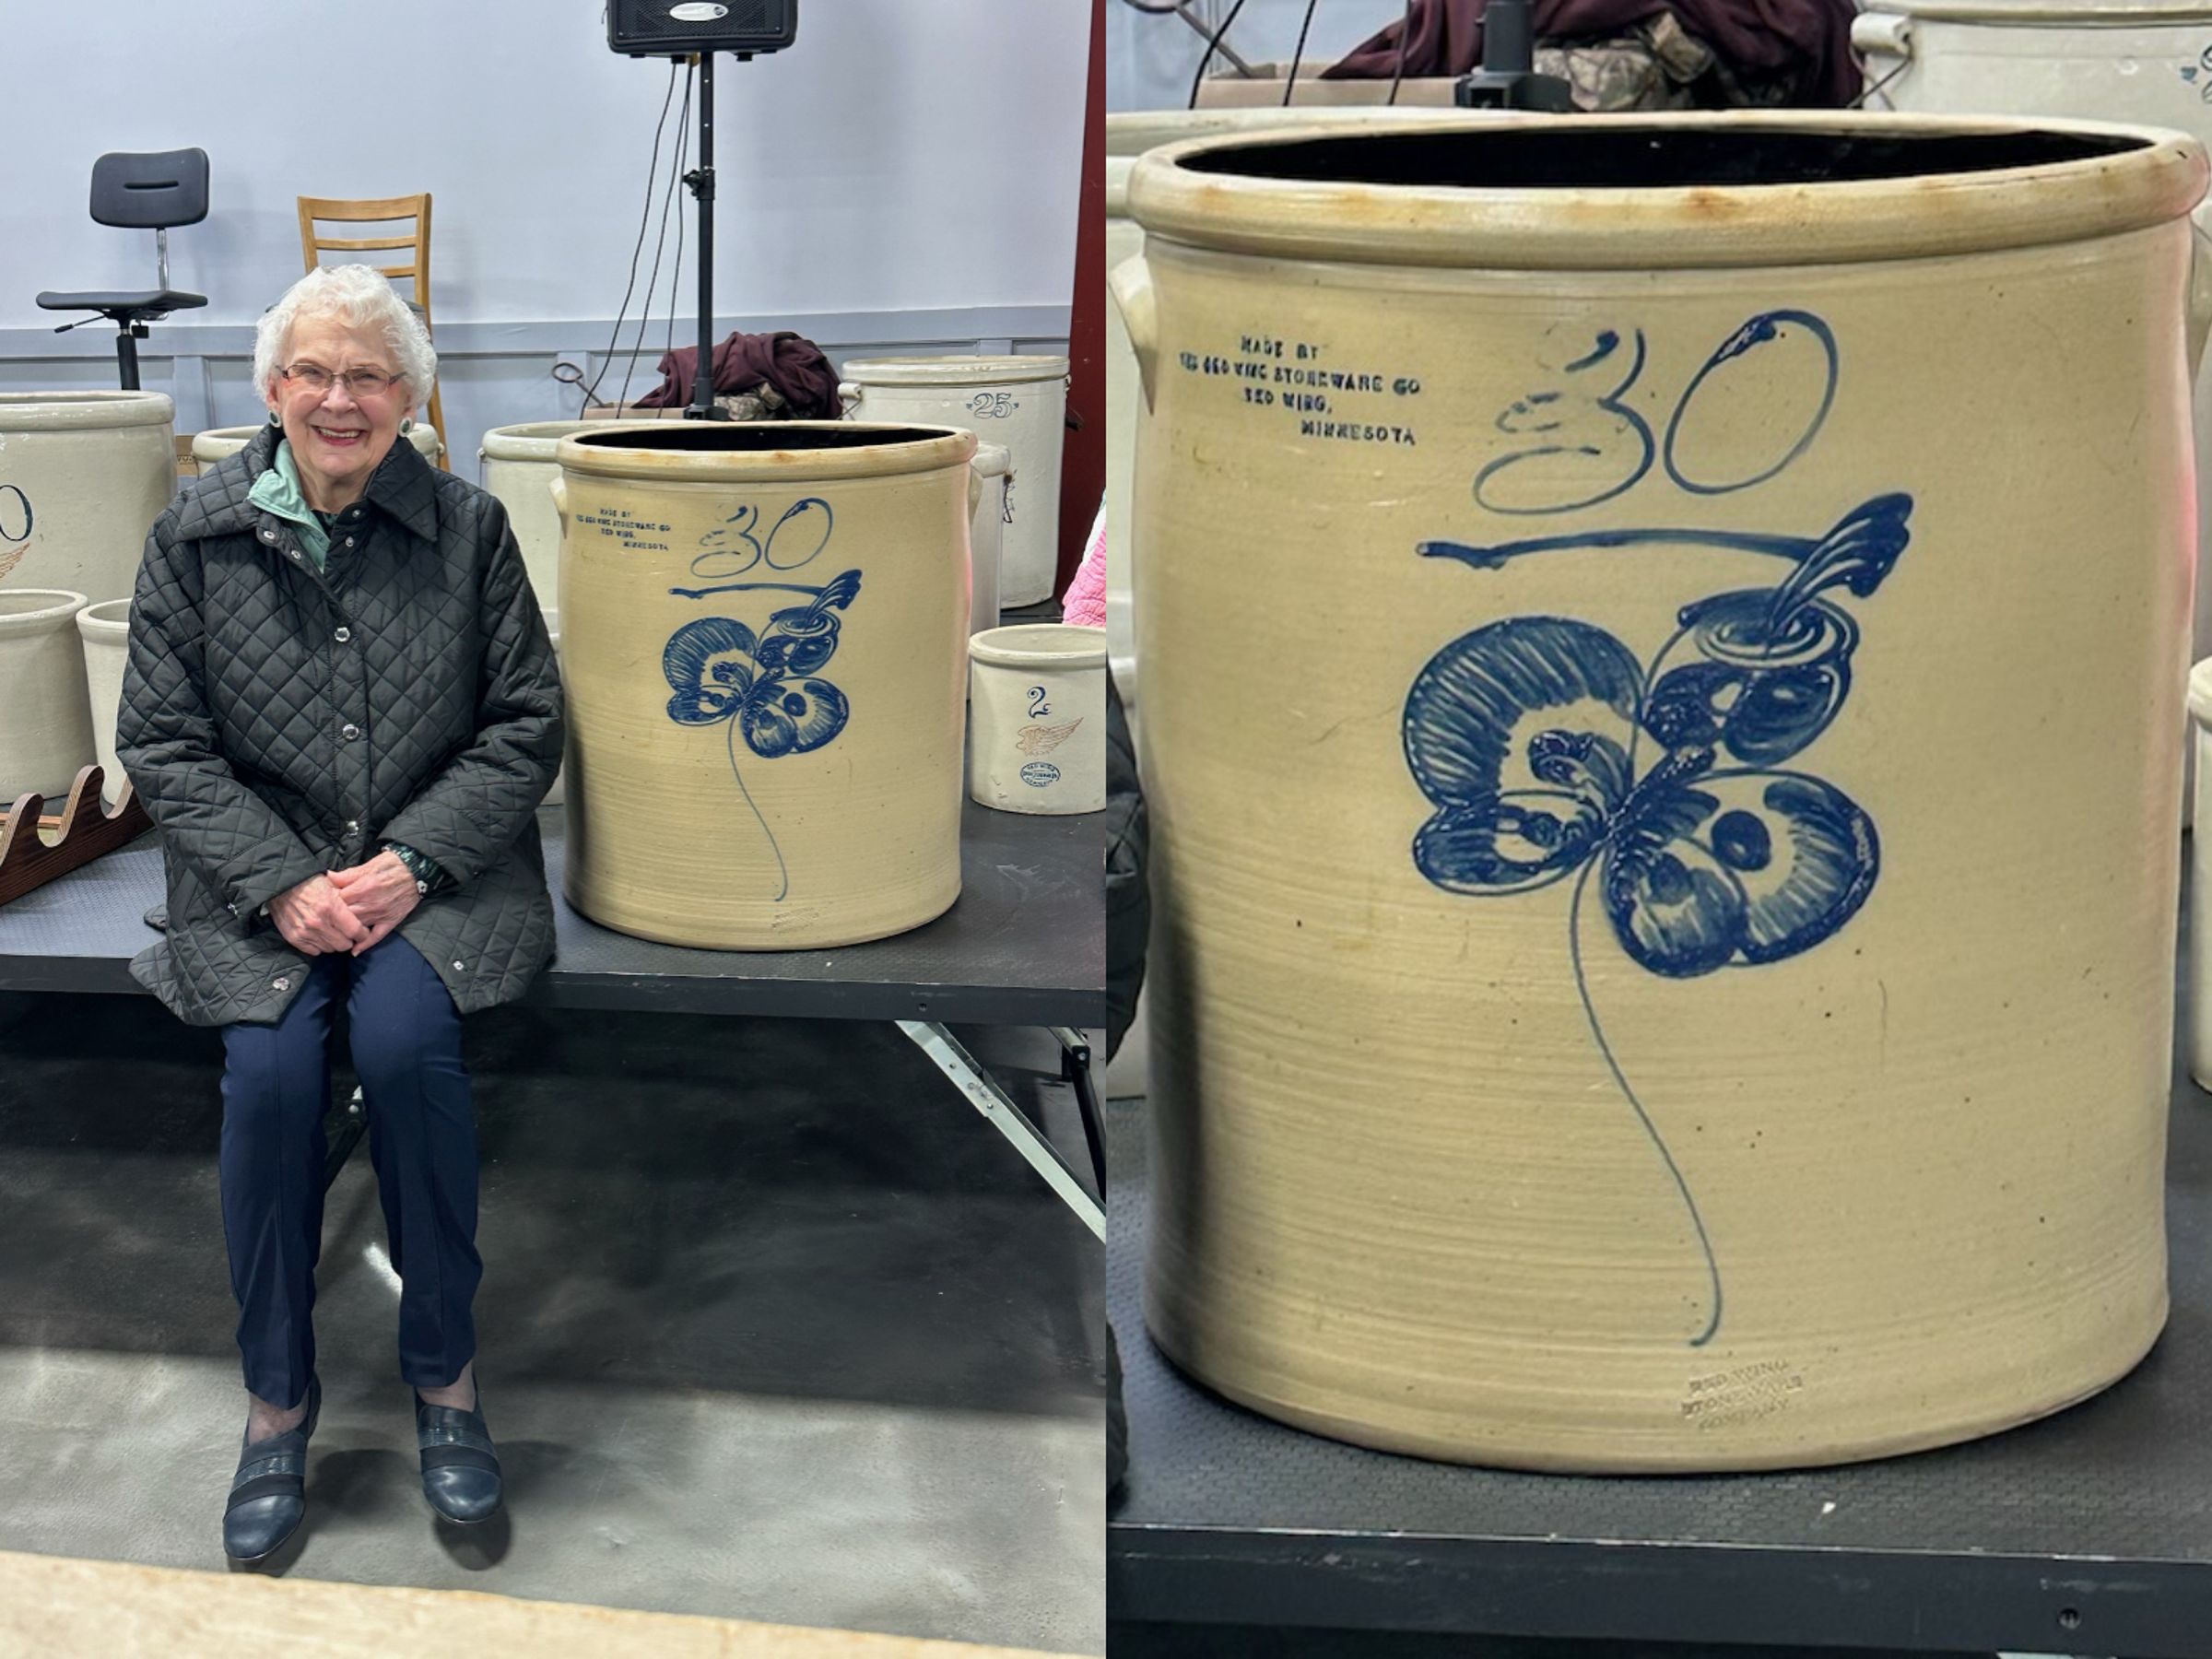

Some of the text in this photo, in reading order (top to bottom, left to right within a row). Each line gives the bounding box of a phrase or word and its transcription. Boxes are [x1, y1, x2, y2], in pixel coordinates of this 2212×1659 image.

[1241, 335, 1282, 359] MADE
[1274, 366, 1383, 393] STONEWARE
[973, 393, 1013, 418] 25
[1473, 309, 1839, 515] 30
[1301, 420, 1416, 446] MINNESOTA
[691, 498, 833, 578] 30
[1027, 686, 1052, 718] 2
